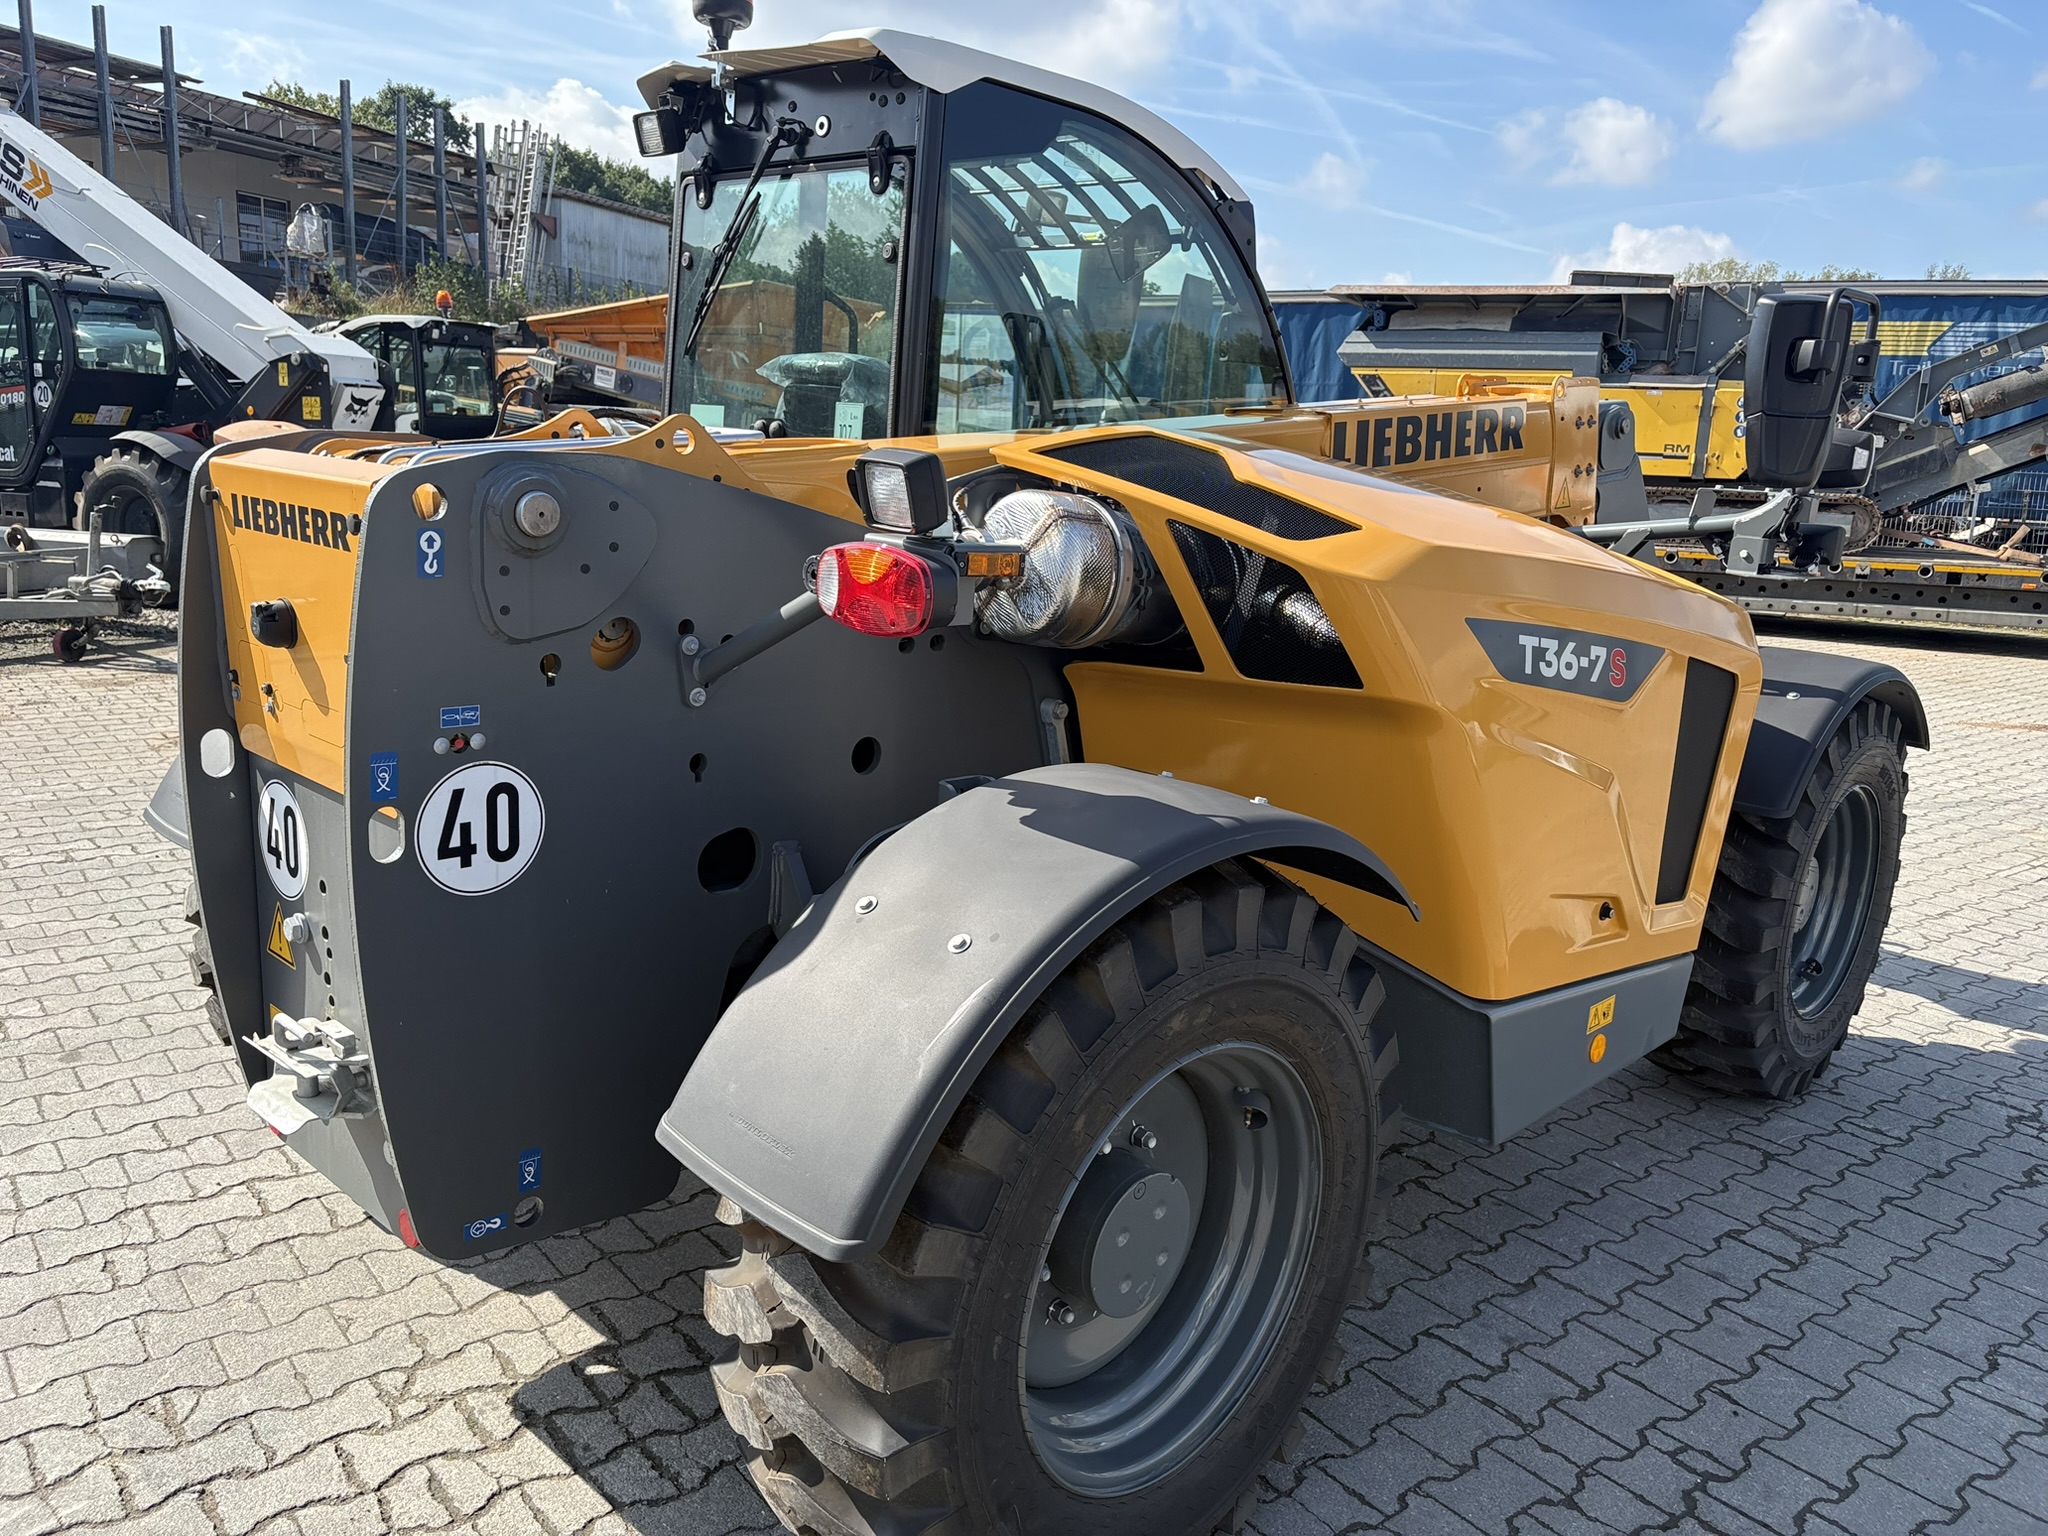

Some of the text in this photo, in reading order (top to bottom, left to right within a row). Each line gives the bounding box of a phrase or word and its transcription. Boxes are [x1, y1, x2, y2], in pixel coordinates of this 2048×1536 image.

[37, 385, 49, 403] 20
[1333, 406, 1525, 468] LIEBHERR
[1663, 443, 1690, 453] RM
[231, 493, 352, 553] LIEBHERR
[266, 796, 299, 879] 40
[436, 781, 520, 869] 40
